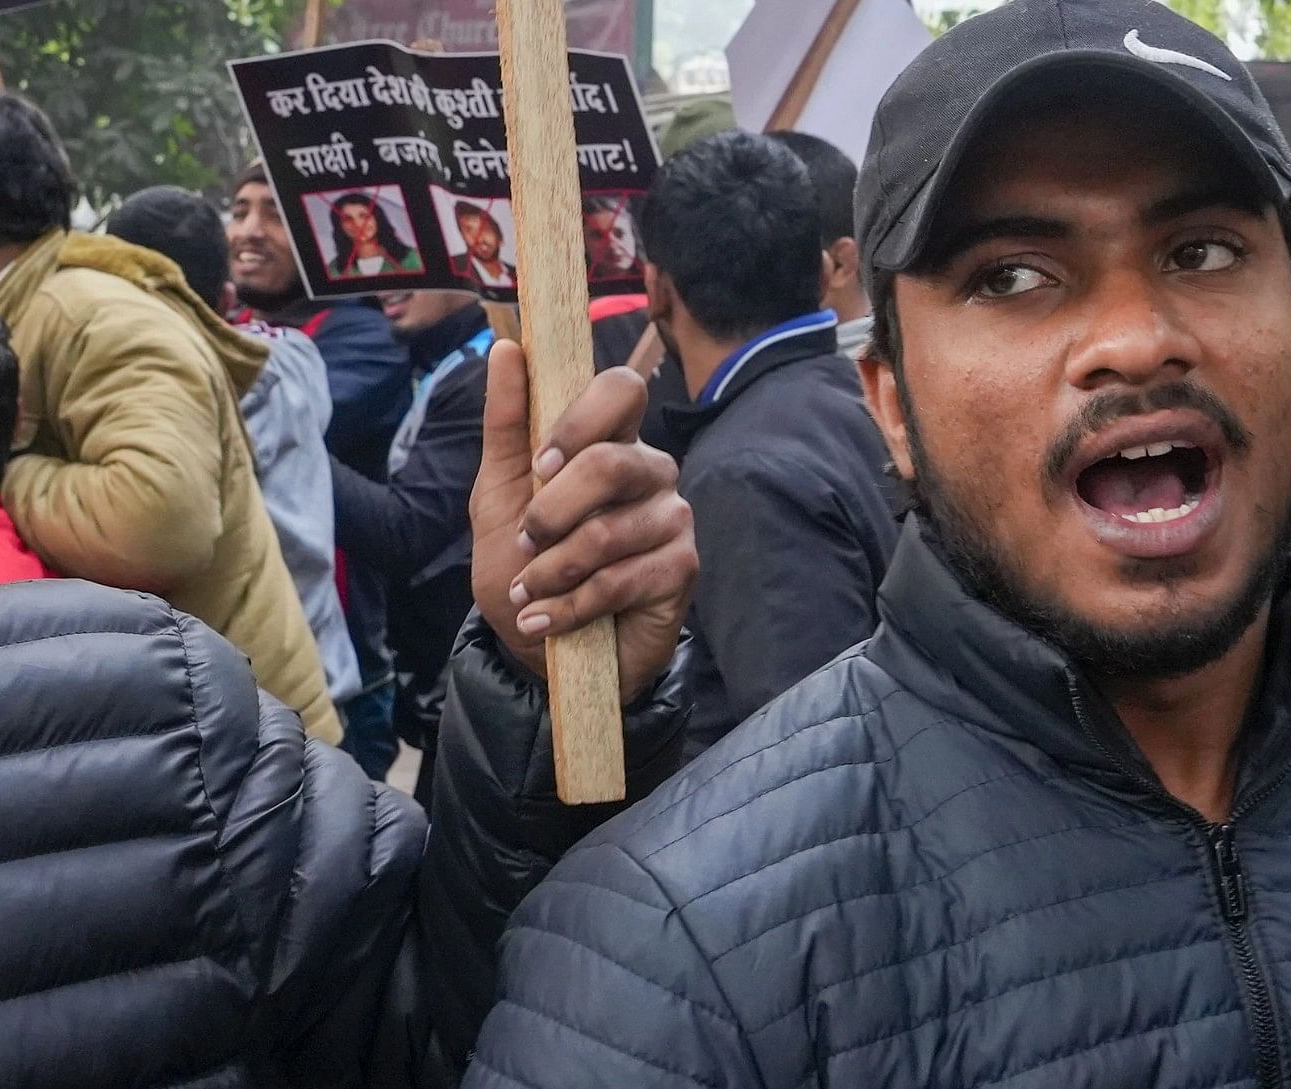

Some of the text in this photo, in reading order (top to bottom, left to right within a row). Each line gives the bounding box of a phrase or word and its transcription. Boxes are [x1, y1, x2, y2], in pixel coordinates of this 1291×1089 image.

[266, 86, 310, 118] कर
[305, 73, 369, 114] दिया
[365, 65, 411, 106] देश
[431, 77, 500, 130] कुश्ती
[286, 132, 370, 178] साक्षी,
[577, 138, 639, 174] गाट!
